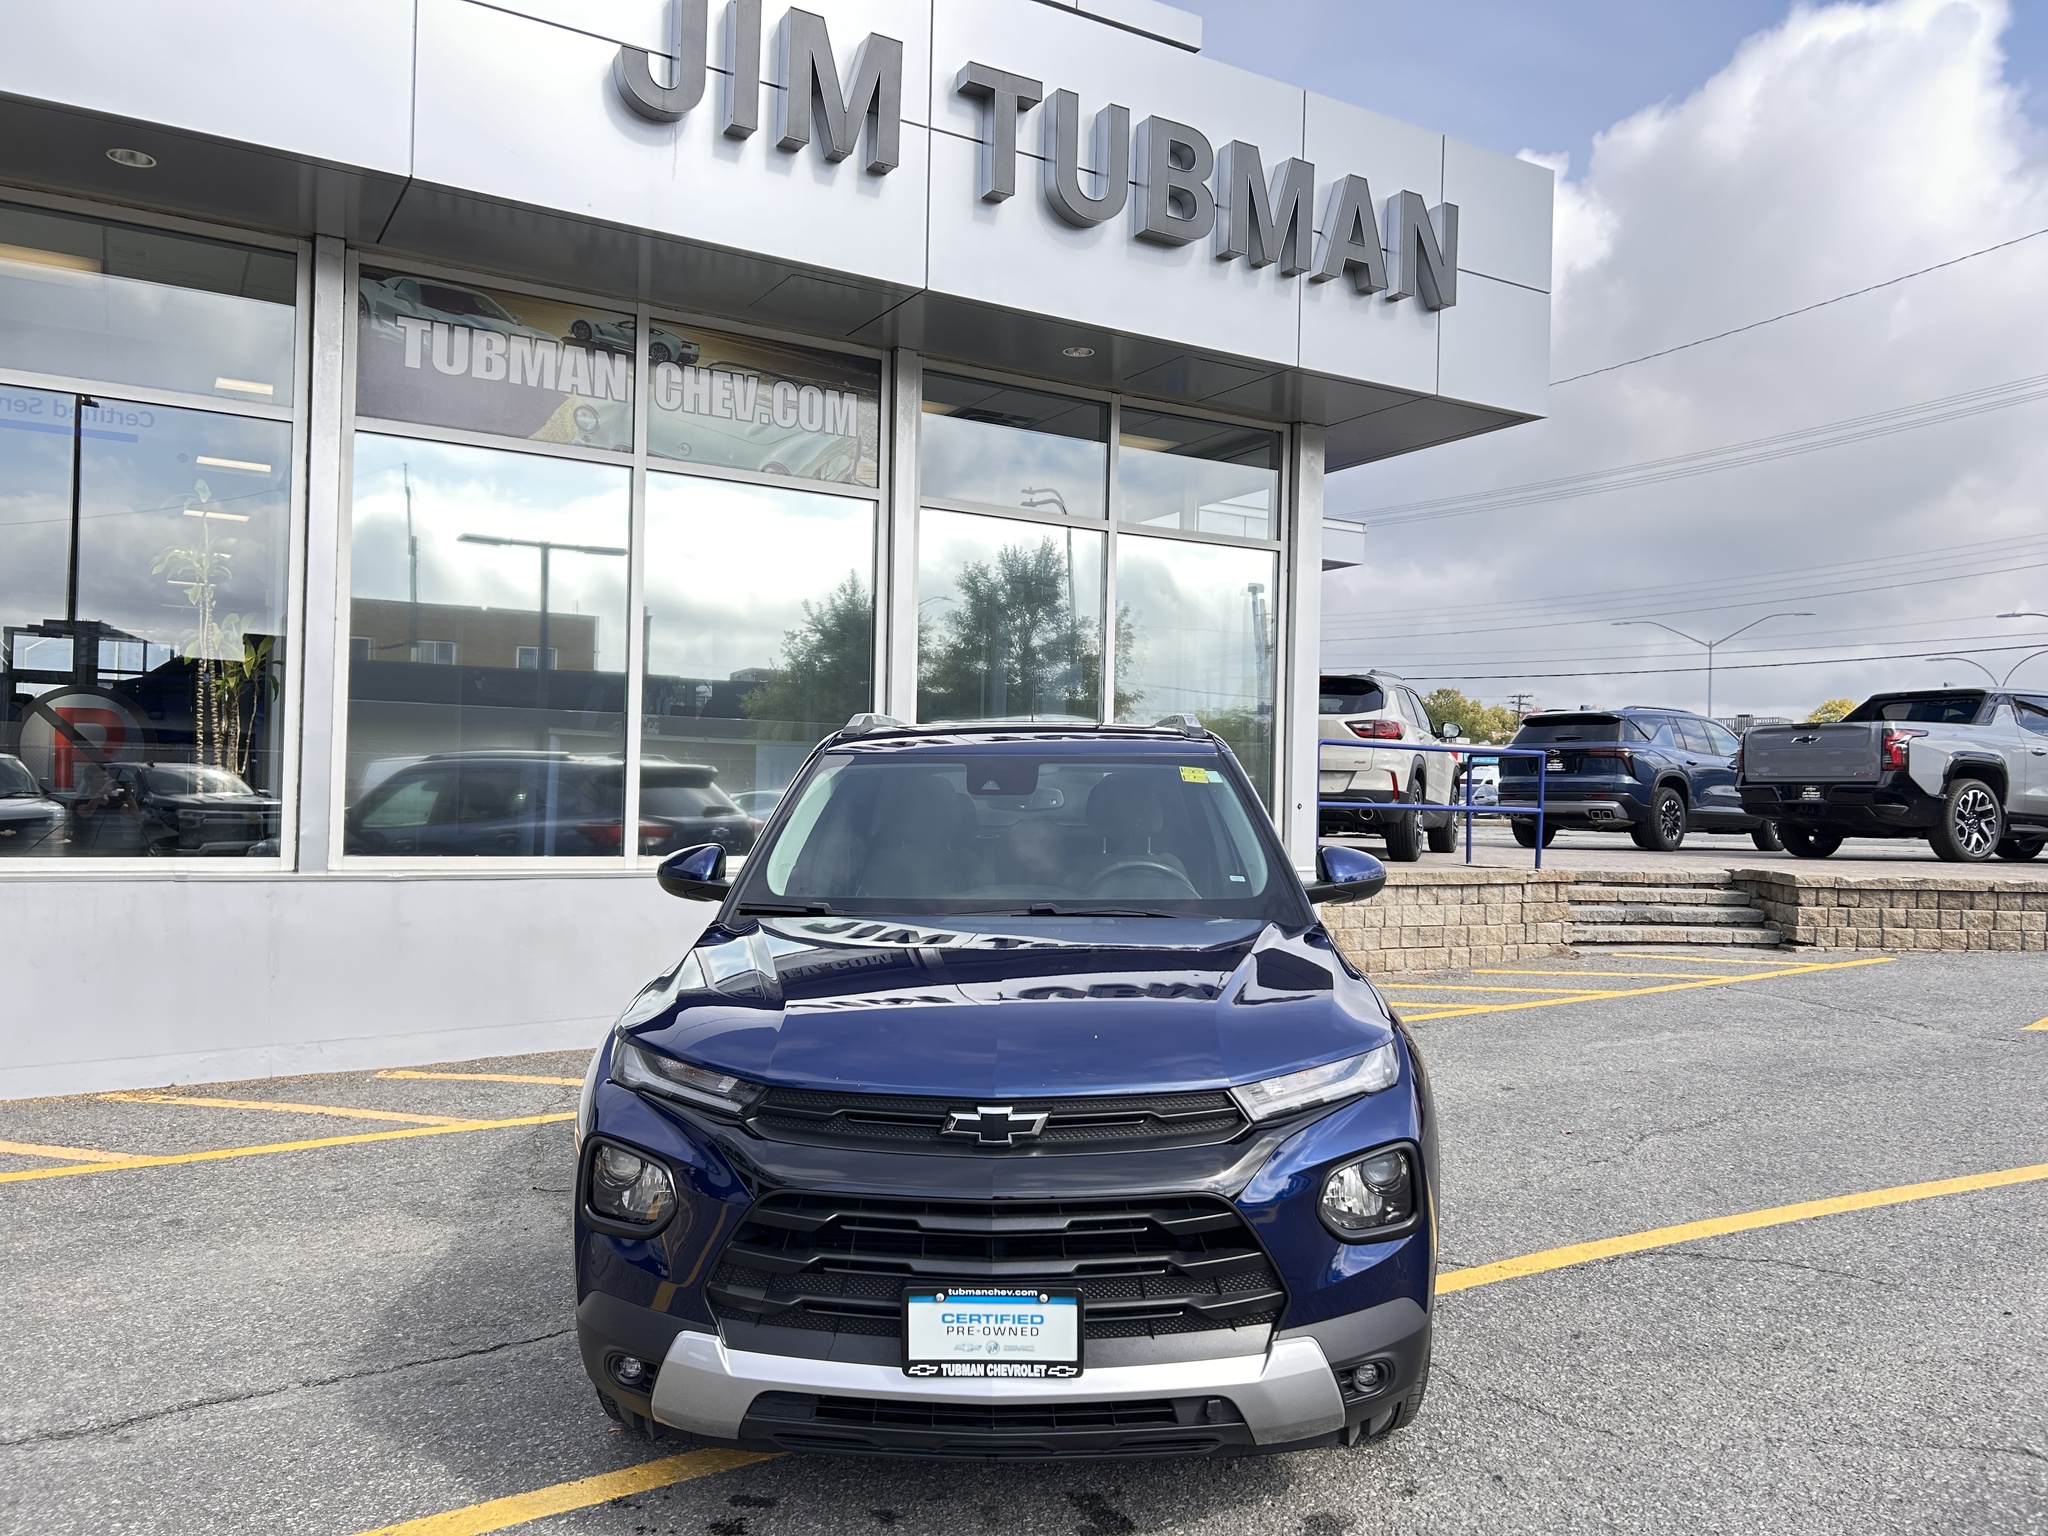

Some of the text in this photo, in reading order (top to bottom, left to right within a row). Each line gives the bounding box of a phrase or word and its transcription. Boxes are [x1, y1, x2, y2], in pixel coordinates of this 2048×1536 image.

[612, 0, 1459, 311] JIM TUBMAN
[395, 315, 860, 438] TUBMAN CHEV.COM
[948, 1288, 1038, 1296] tubmanchev.com
[941, 1313, 1044, 1325] CERTIFIED
[946, 1326, 1040, 1337] PRE-OWNED
[941, 1363, 1047, 1377] TUBMAN CHEVROLET
